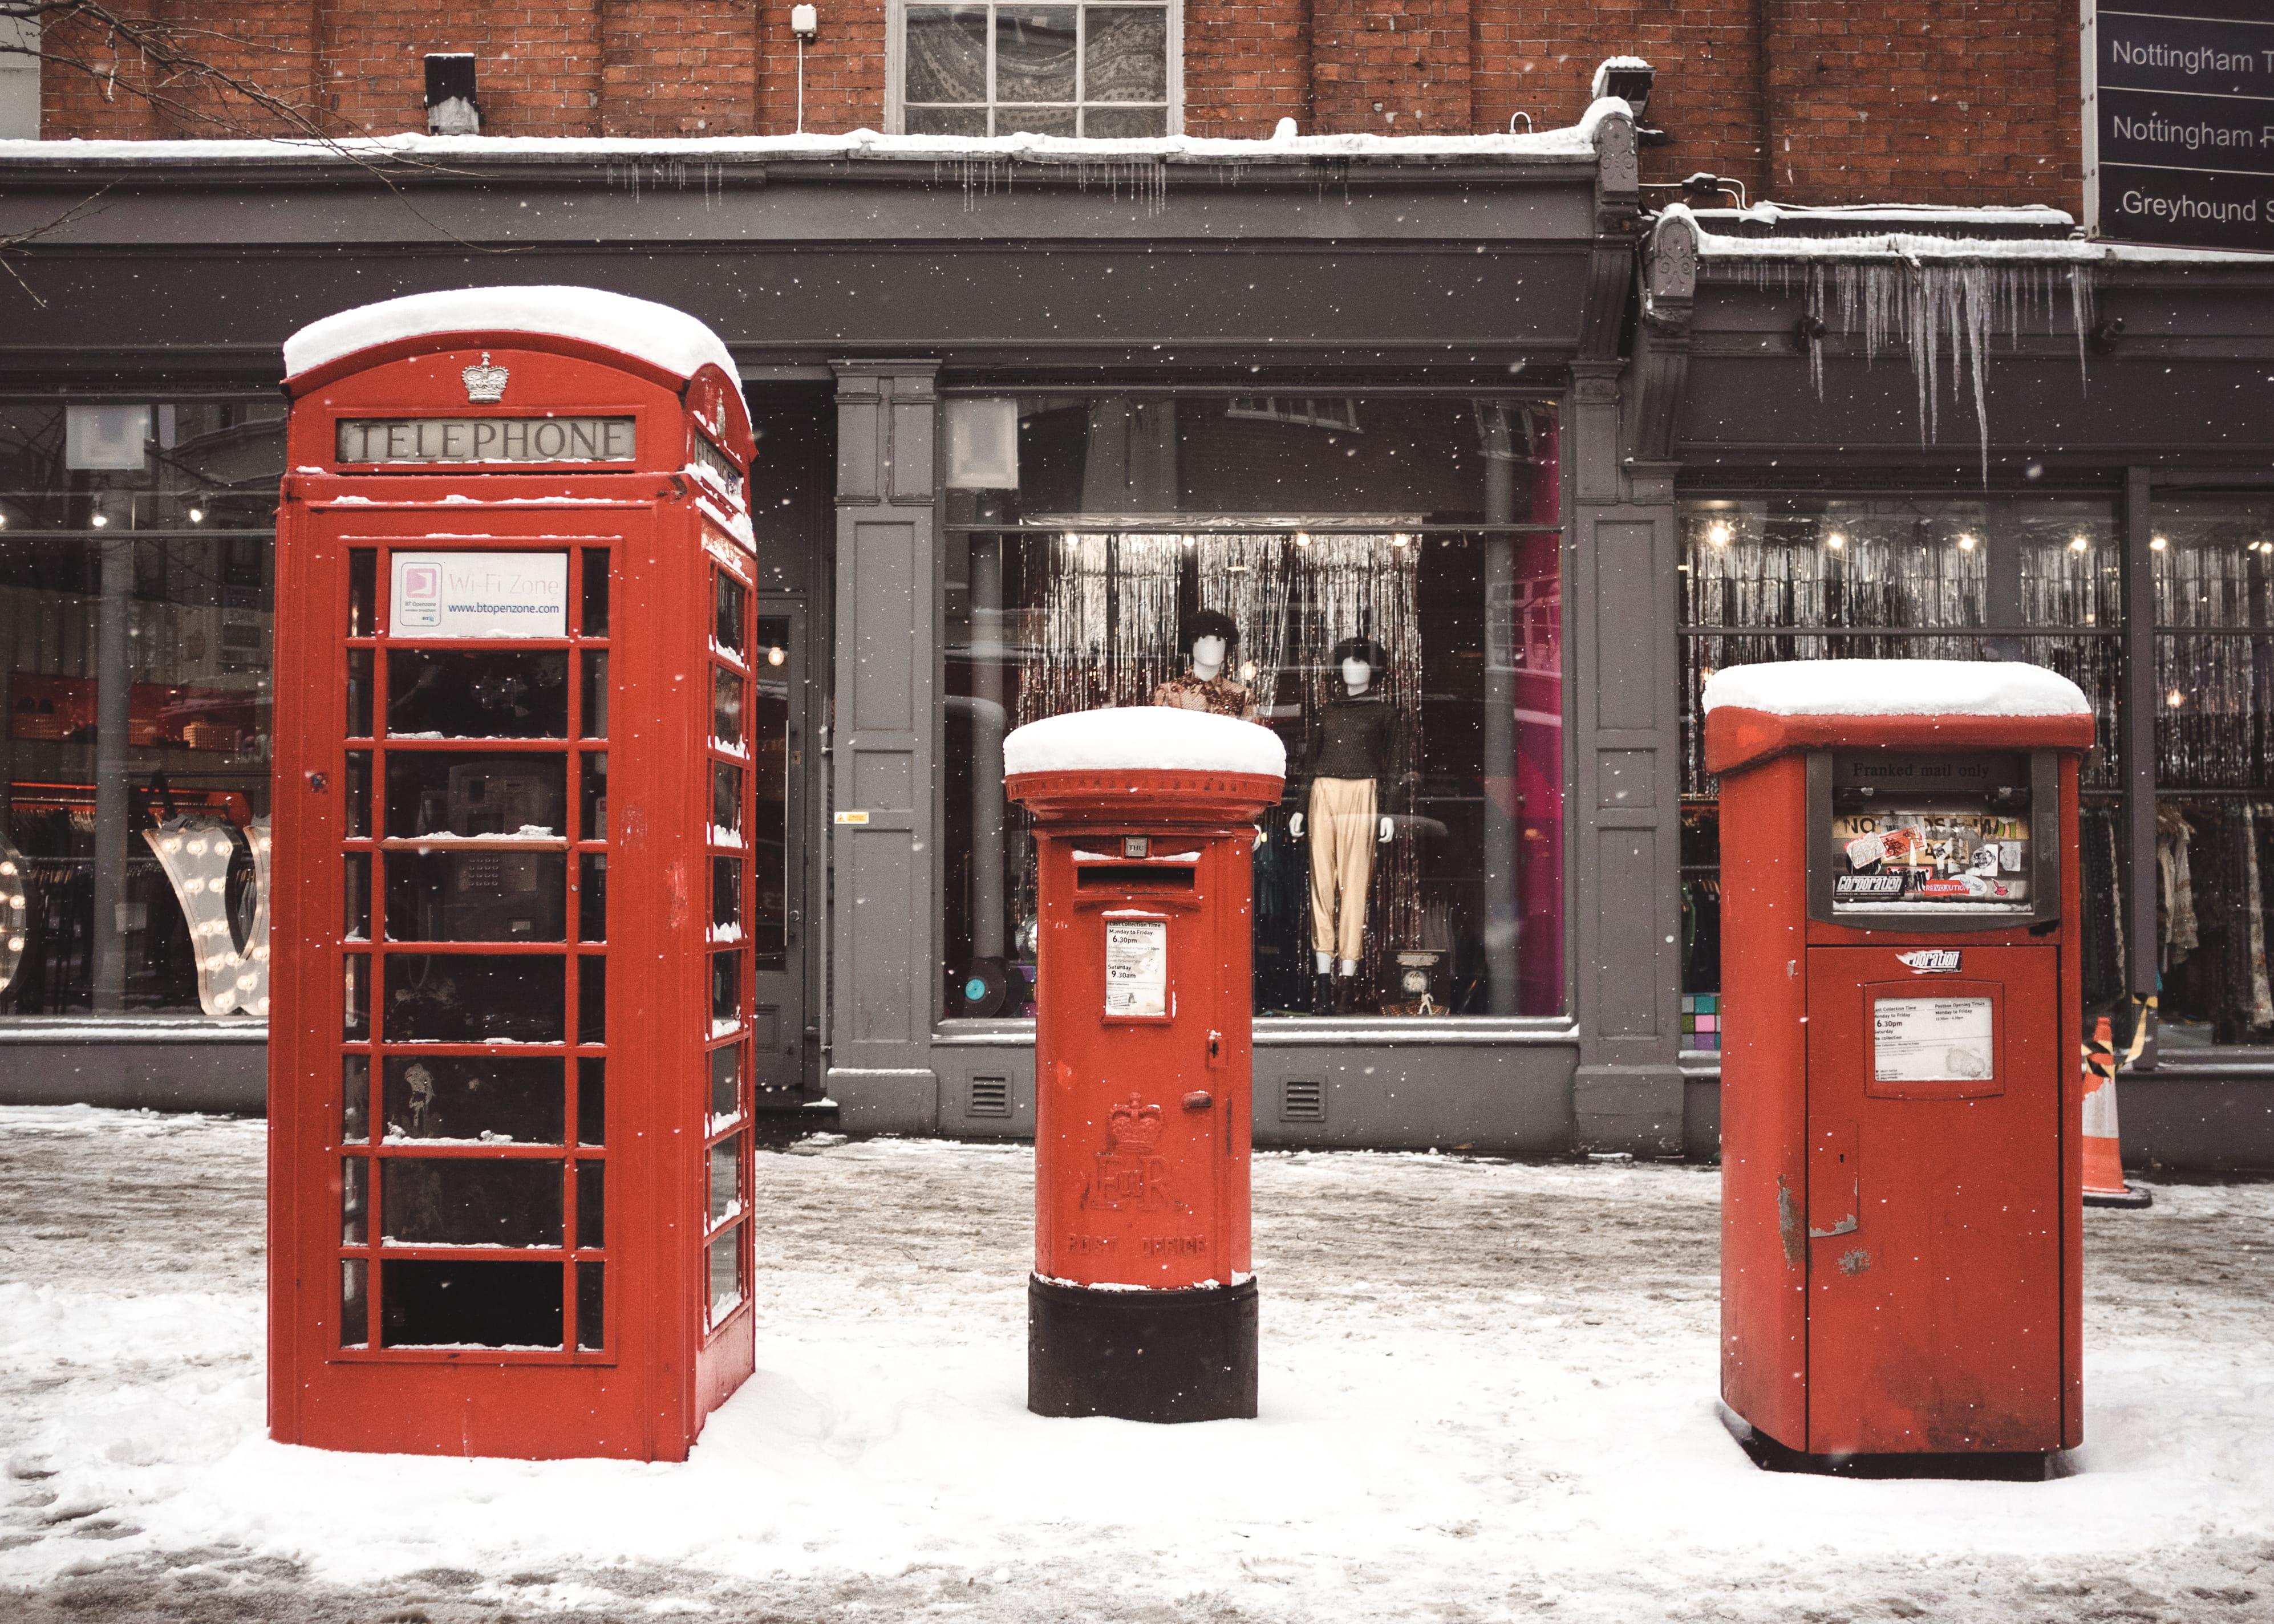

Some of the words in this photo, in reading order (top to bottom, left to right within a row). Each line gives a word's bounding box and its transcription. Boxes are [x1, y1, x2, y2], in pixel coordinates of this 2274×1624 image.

[2113, 40, 2253, 75] Nottingham
[2114, 116, 2253, 150] Nottingham
[2122, 190, 2256, 223] Greyhound
[352, 422, 625, 458] TELEPHONE
[449, 573, 501, 594] Wi-Fi
[509, 574, 559, 595] Zone
[448, 602, 560, 615] www.btopenzone.com
[1854, 762, 1913, 777] Franked
[1920, 764, 1951, 777] mail
[1959, 764, 1989, 779] only
[1837, 875, 1903, 892] Corporation
[1112, 935, 1137, 944] 6.30pm
[1111, 970, 1136, 979] 9.30am
[1876, 1019, 1903, 1028] 6.30pm
